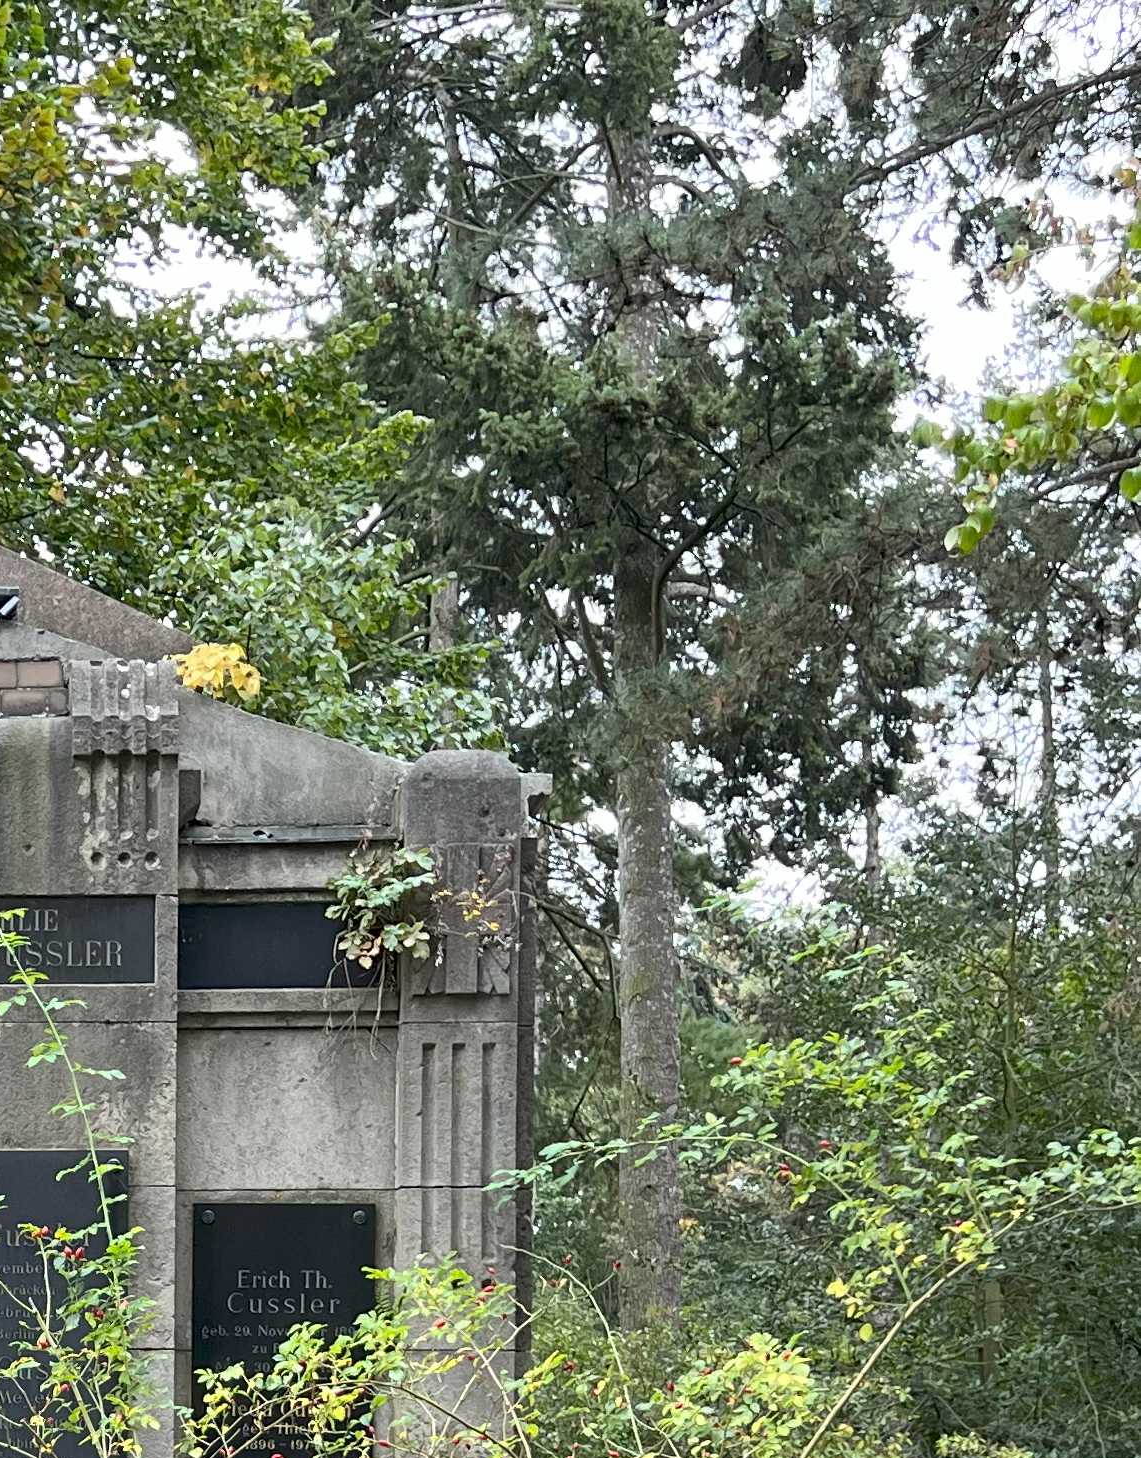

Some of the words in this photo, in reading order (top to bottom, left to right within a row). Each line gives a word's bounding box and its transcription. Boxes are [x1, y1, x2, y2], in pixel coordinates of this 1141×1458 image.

[237, 1270, 291, 1289] Erich
[300, 1270, 333, 1289] Th.
[227, 1292, 341, 1314] Cussler
[201, 1324, 229, 1339] geb.
